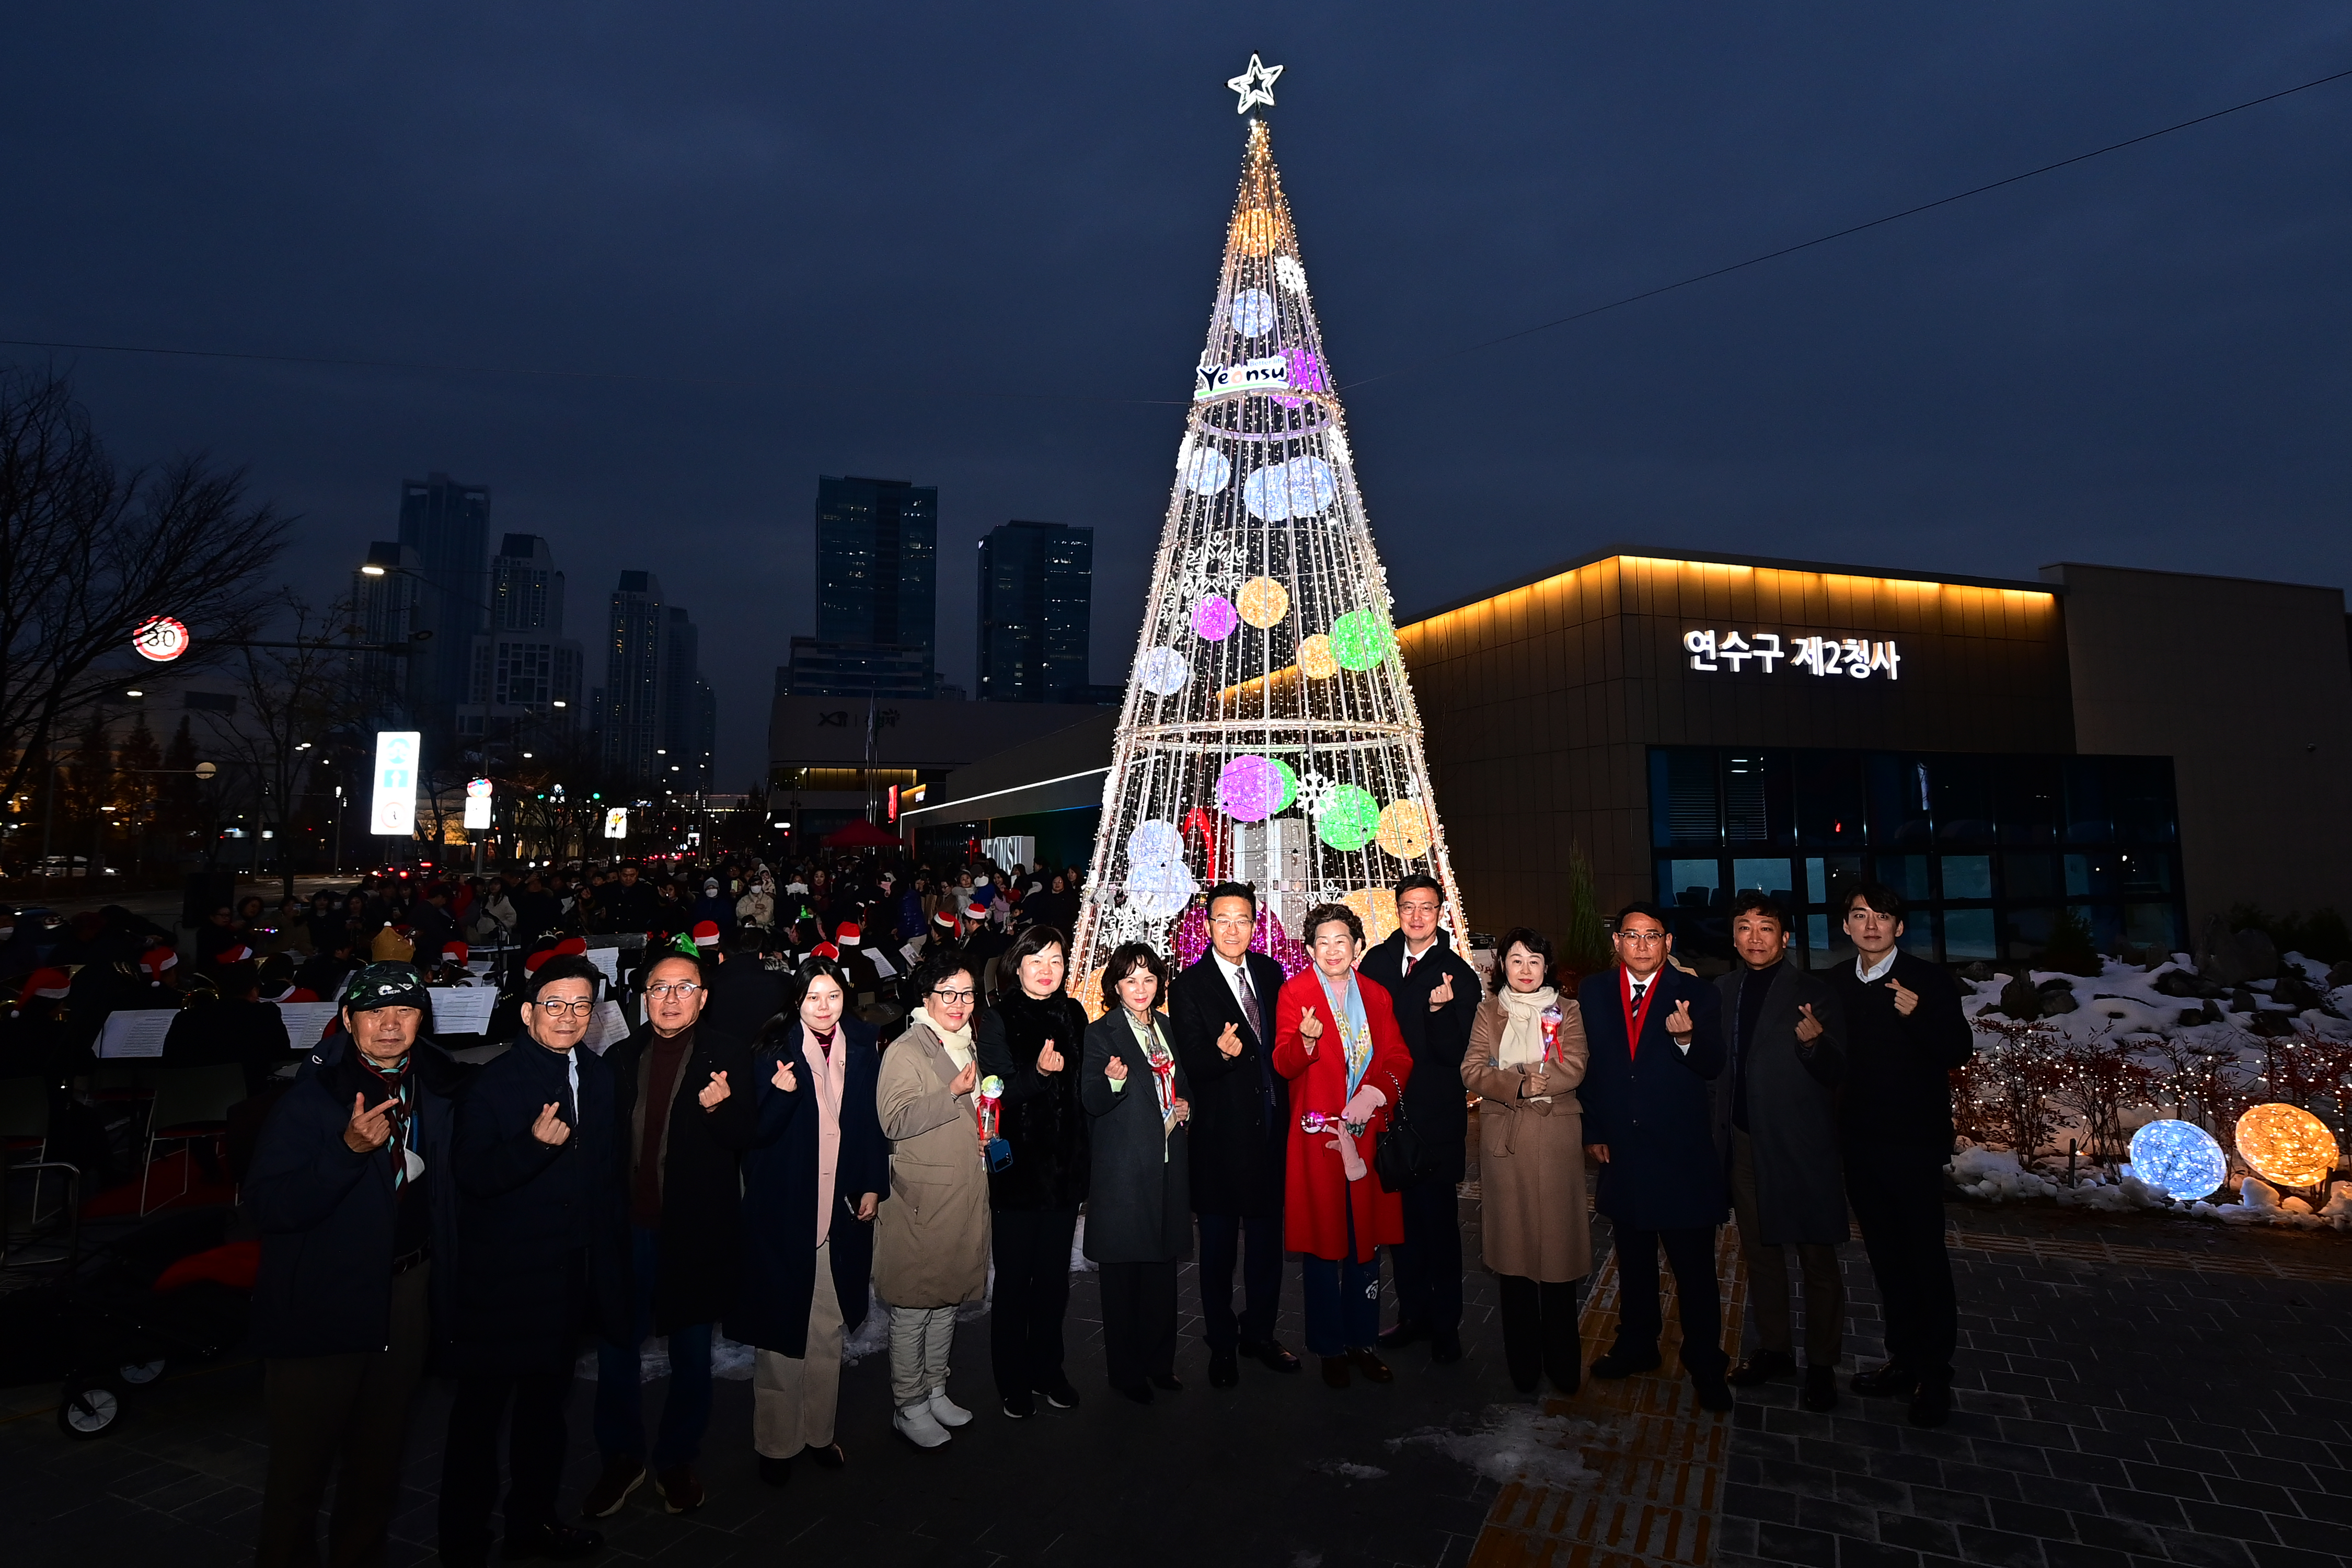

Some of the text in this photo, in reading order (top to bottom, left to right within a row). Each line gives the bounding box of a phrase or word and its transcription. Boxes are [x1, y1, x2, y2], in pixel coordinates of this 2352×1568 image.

[1200, 366, 1284, 391] Yeonsu
[1684, 629, 1900, 680] 연수구 제2청사
